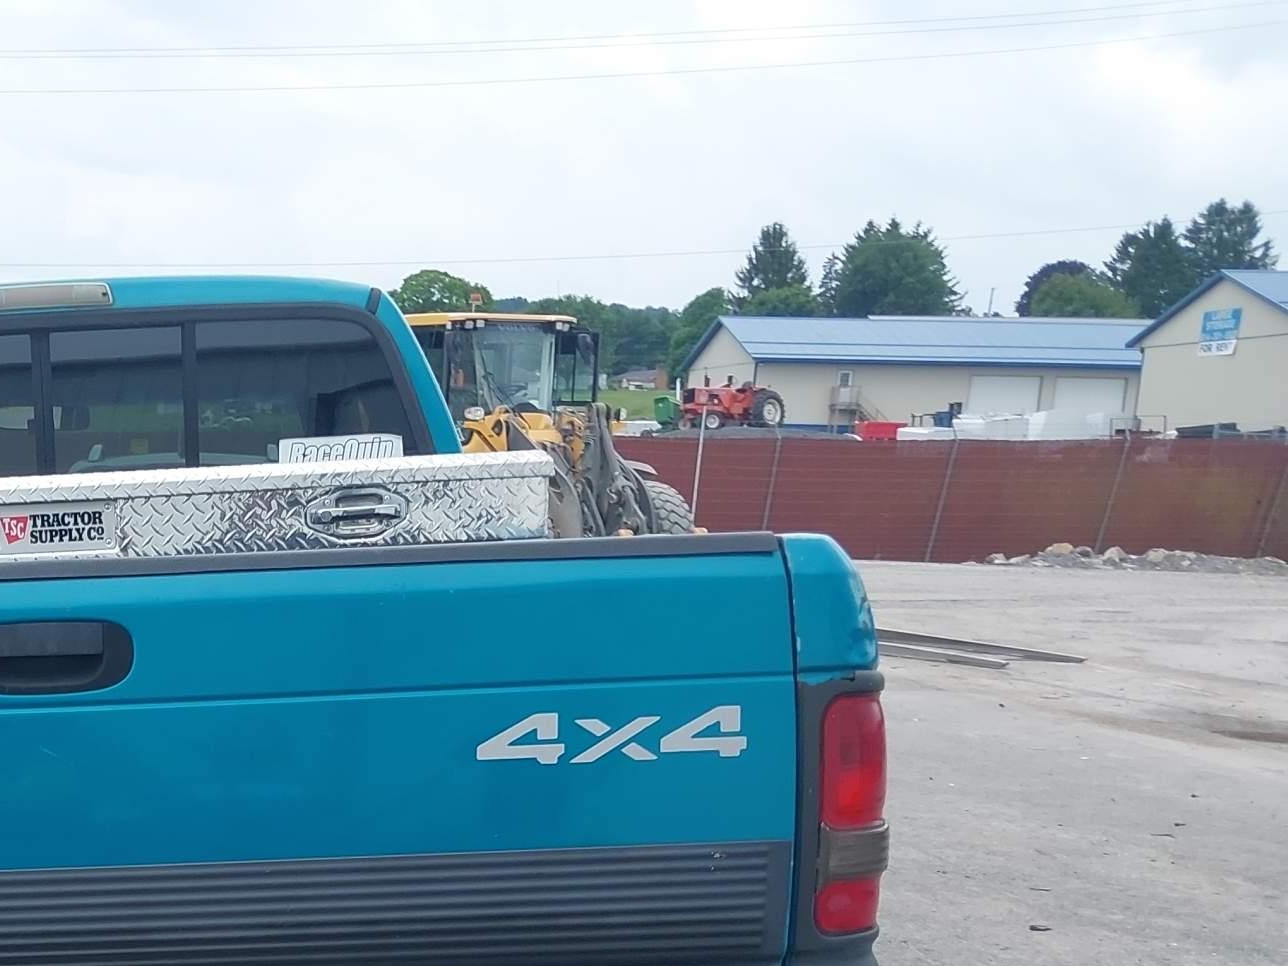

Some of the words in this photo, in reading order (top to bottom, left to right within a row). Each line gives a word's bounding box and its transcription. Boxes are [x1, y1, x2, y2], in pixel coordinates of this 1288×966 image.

[2, 517, 25, 539] TSC
[29, 511, 104, 528] TRACTOR
[29, 527, 86, 544] SUPPLY
